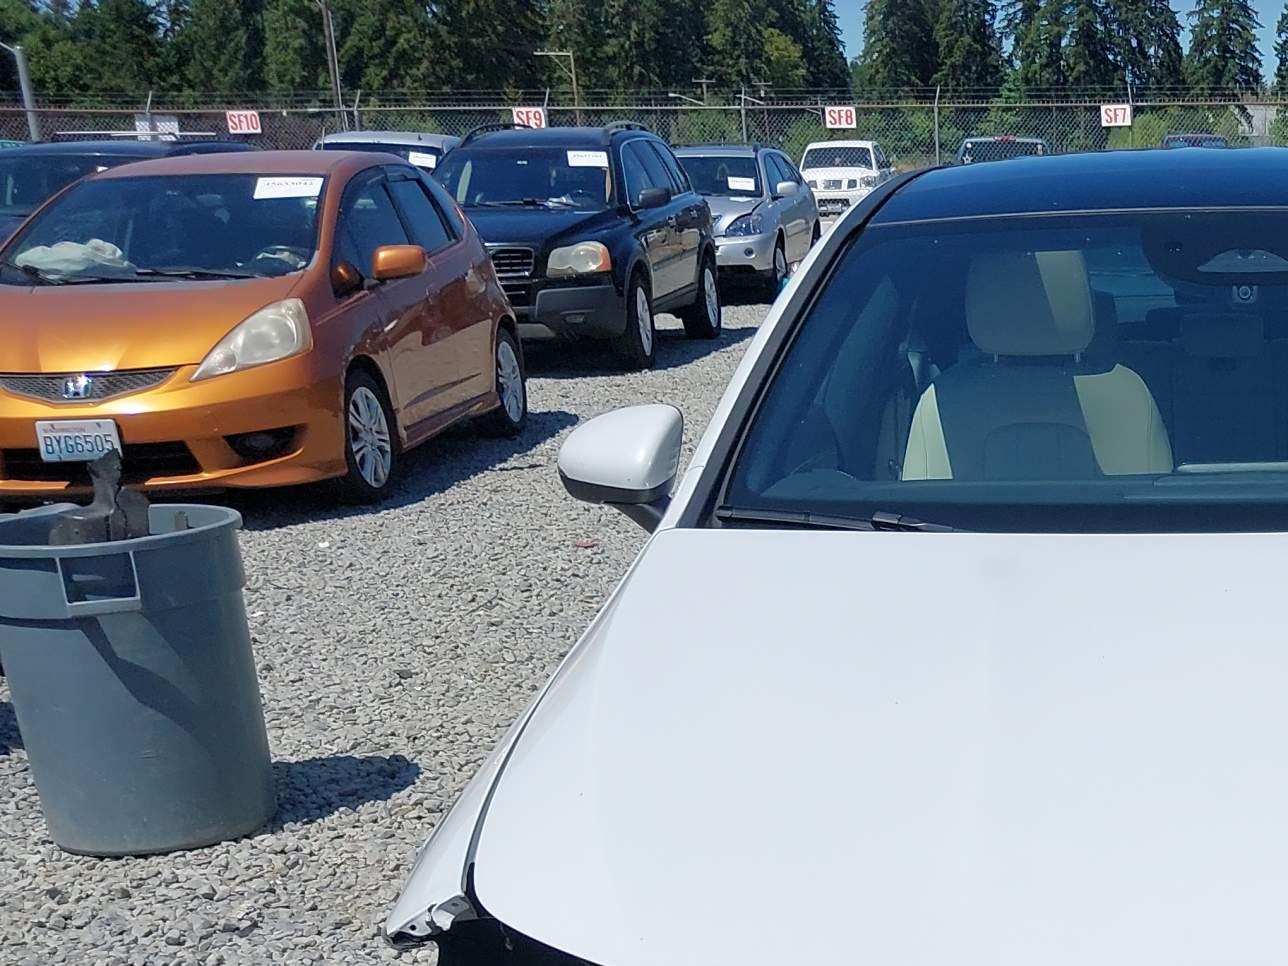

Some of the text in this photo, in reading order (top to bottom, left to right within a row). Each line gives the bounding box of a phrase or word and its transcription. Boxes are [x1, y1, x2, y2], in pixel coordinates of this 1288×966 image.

[229, 113, 259, 130] SF10
[516, 110, 542, 128] SF9
[828, 109, 853, 125] SF8
[1104, 107, 1126, 123] SF7
[43, 434, 114, 454] BYG6505
